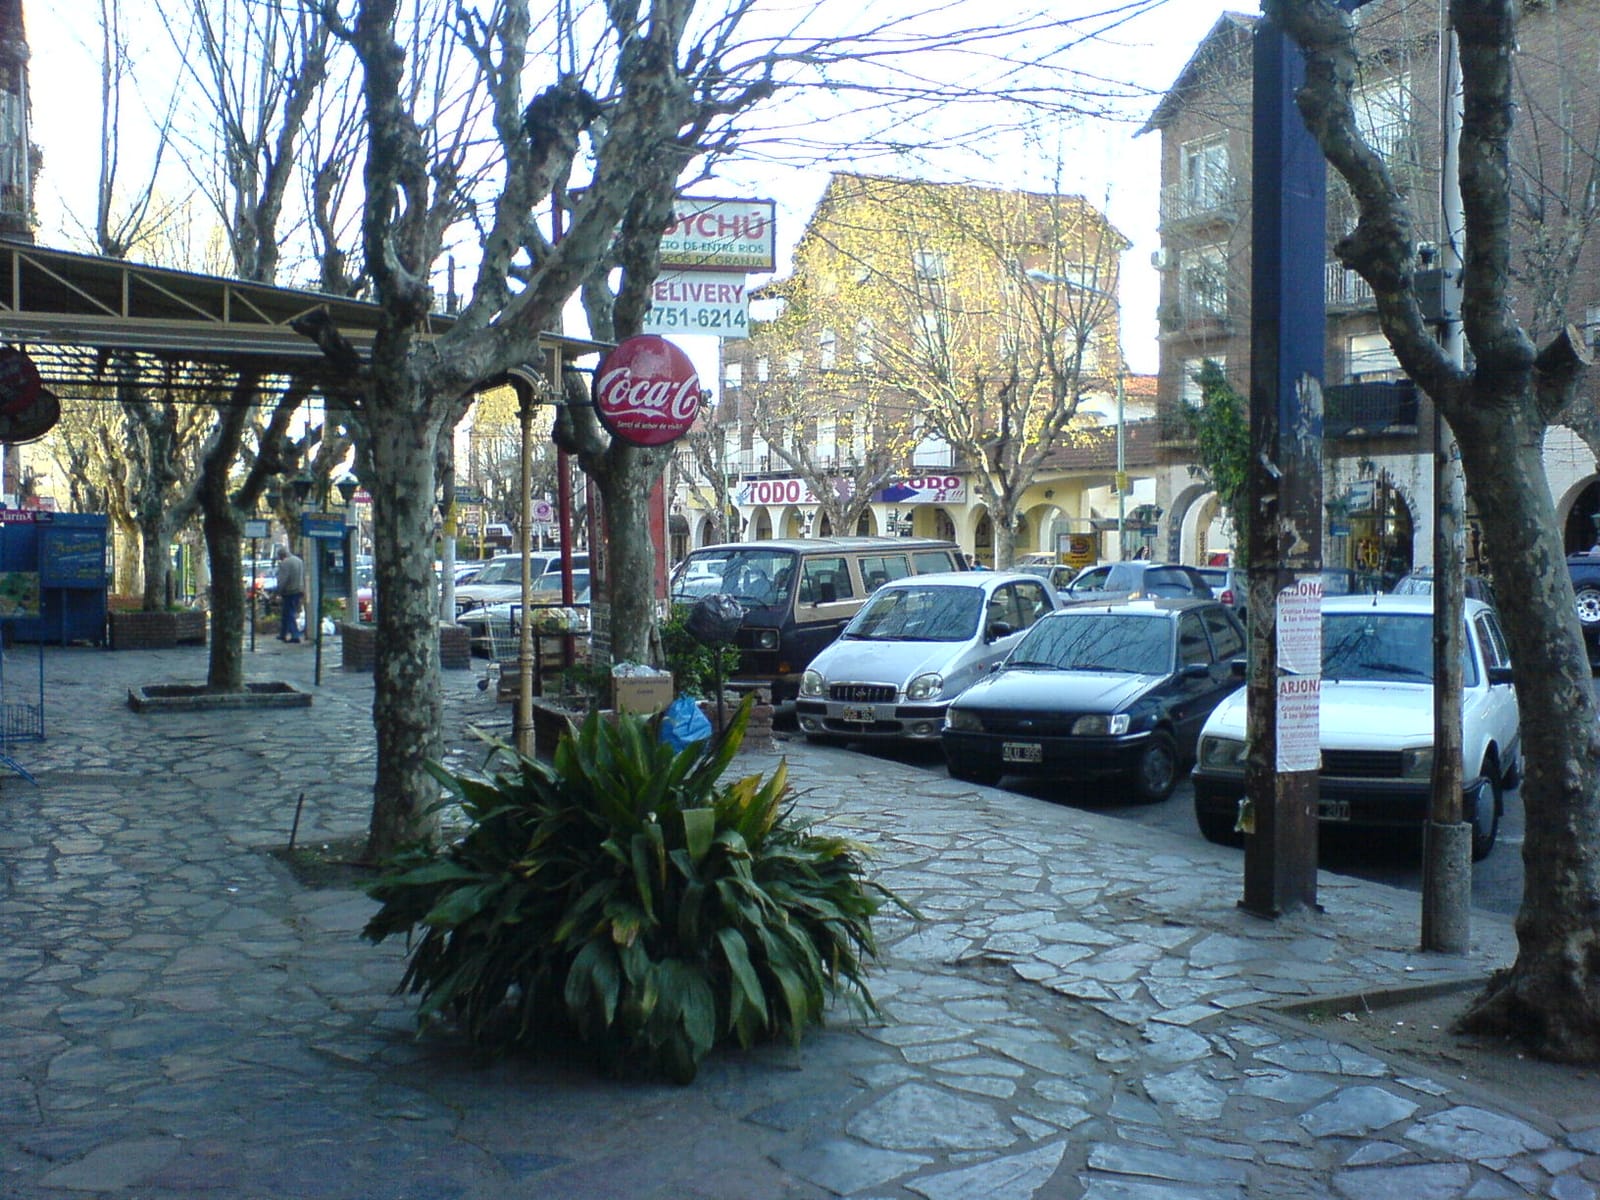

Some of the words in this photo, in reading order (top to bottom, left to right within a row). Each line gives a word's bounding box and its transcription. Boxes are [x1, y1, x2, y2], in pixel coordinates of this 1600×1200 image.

[684, 241, 698, 251] DE
[702, 242, 735, 253] ENTRE
[715, 256, 764, 266] GRANJA
[655, 282, 745, 303] ELIVERY
[644, 307, 746, 328] 4751-6214
[598, 366, 699, 420] Coca-C
[750, 480, 800, 504] TODO
